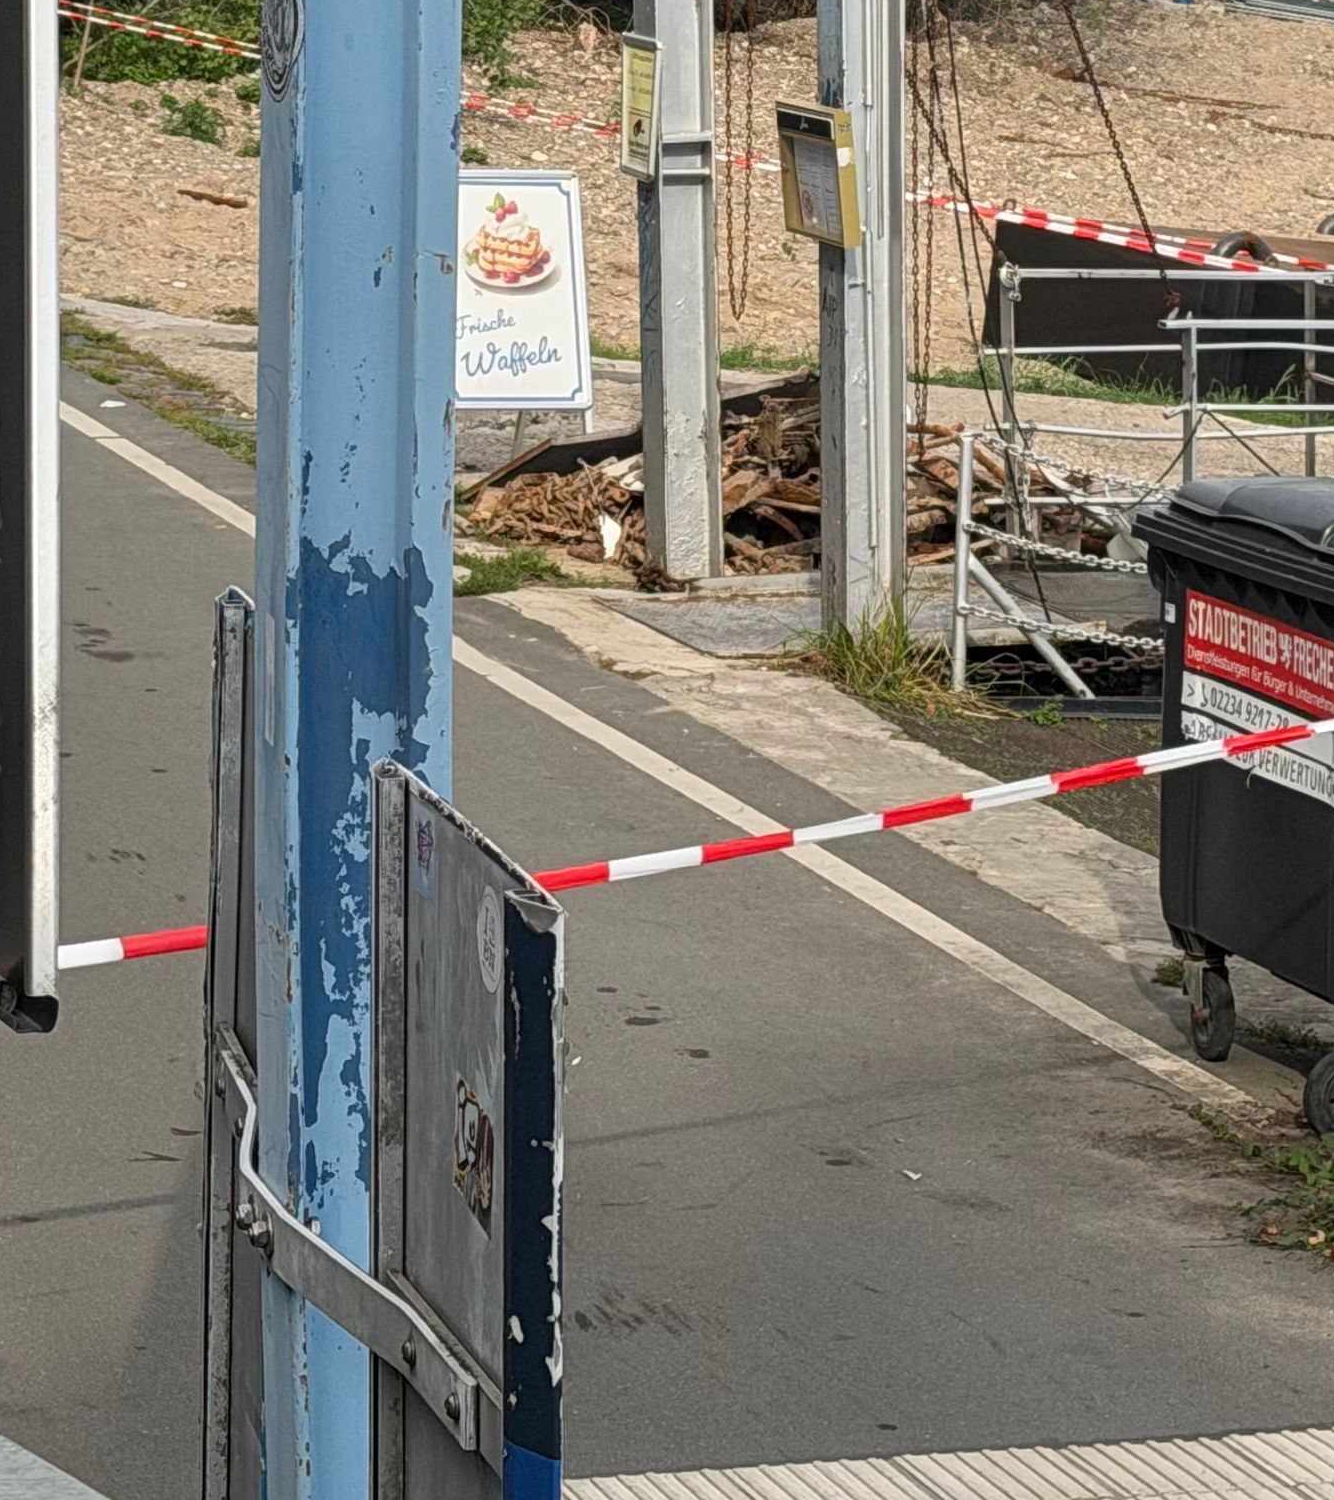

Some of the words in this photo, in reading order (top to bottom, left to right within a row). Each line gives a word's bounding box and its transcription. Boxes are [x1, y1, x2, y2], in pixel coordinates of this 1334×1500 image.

[455, 308, 517, 339] Frische
[460, 336, 563, 377] Waffeln
[1188, 598, 1278, 665] STADTBETRIEB
[1211, 687, 1243, 721] 02234
